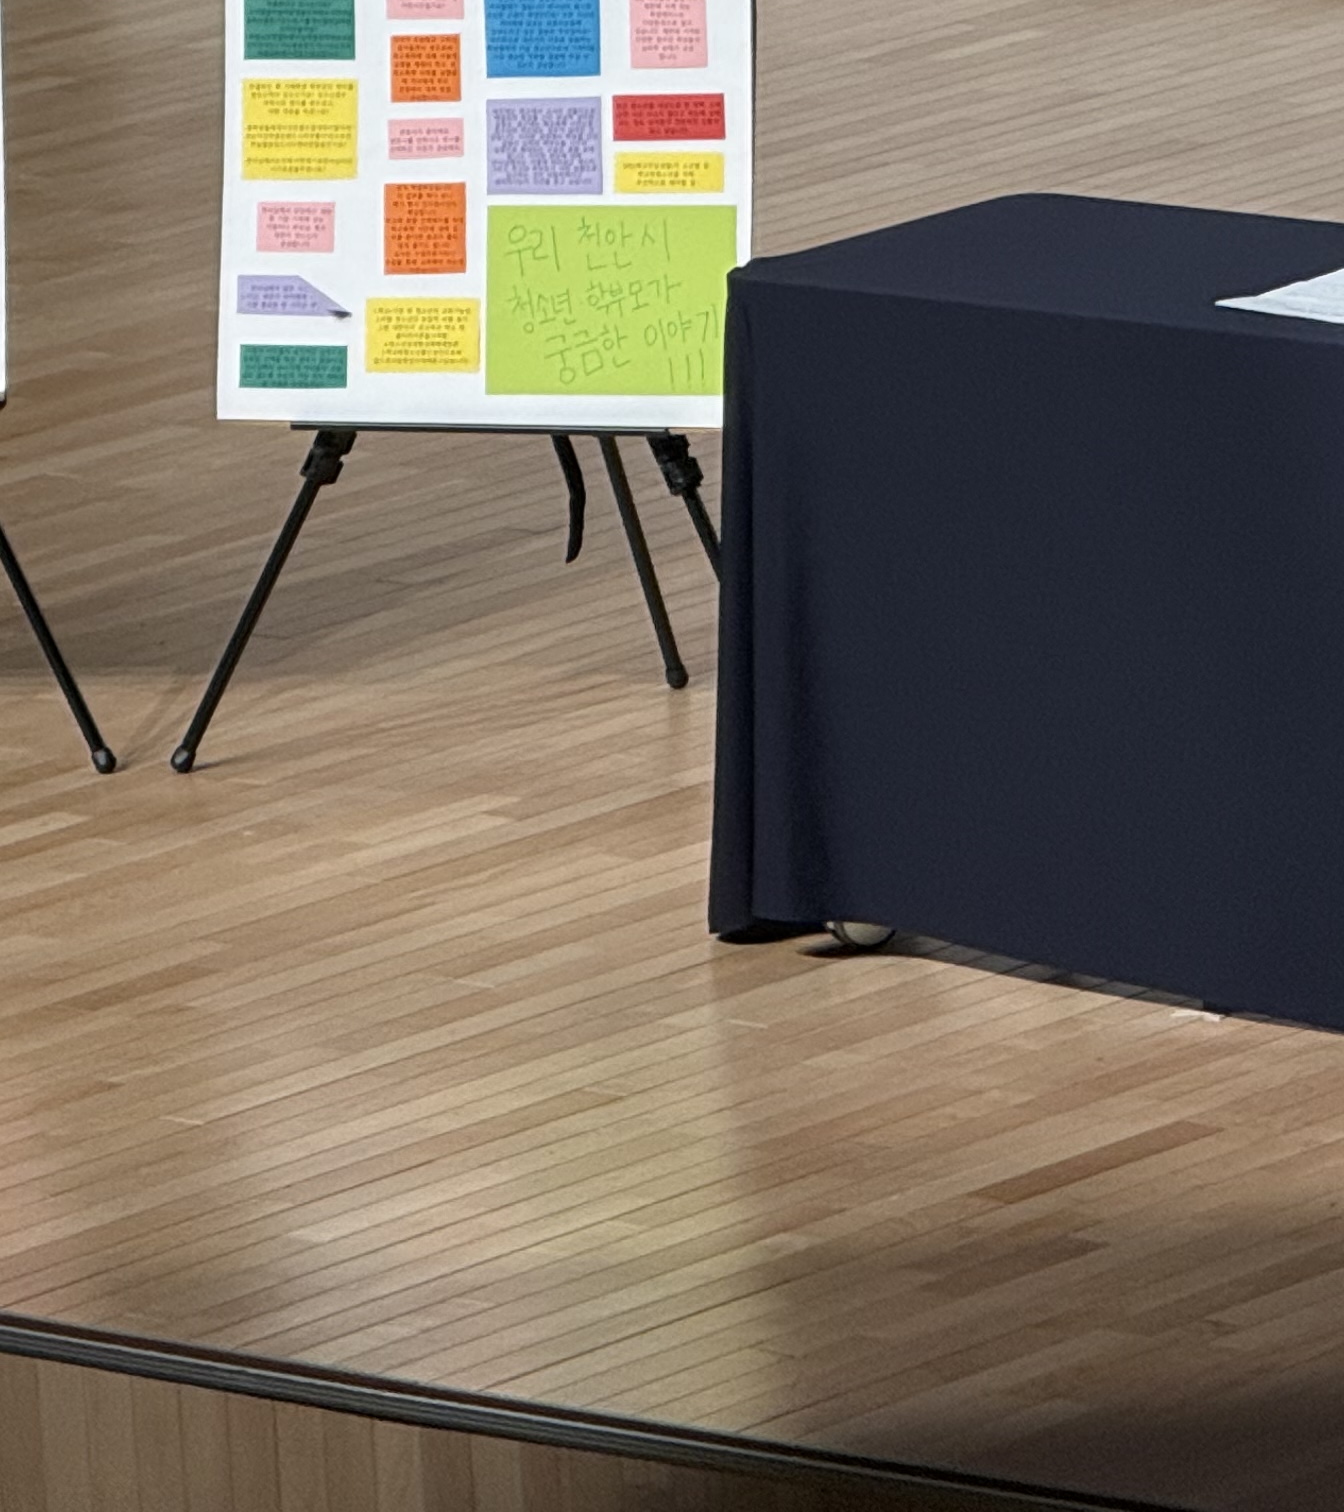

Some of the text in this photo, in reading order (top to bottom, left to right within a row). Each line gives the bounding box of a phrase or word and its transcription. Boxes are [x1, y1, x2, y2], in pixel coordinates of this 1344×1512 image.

[505, 224, 560, 277] 우리
[506, 273, 682, 334] 청소년 학부모가
[544, 303, 719, 385] 궁금한 이야기
